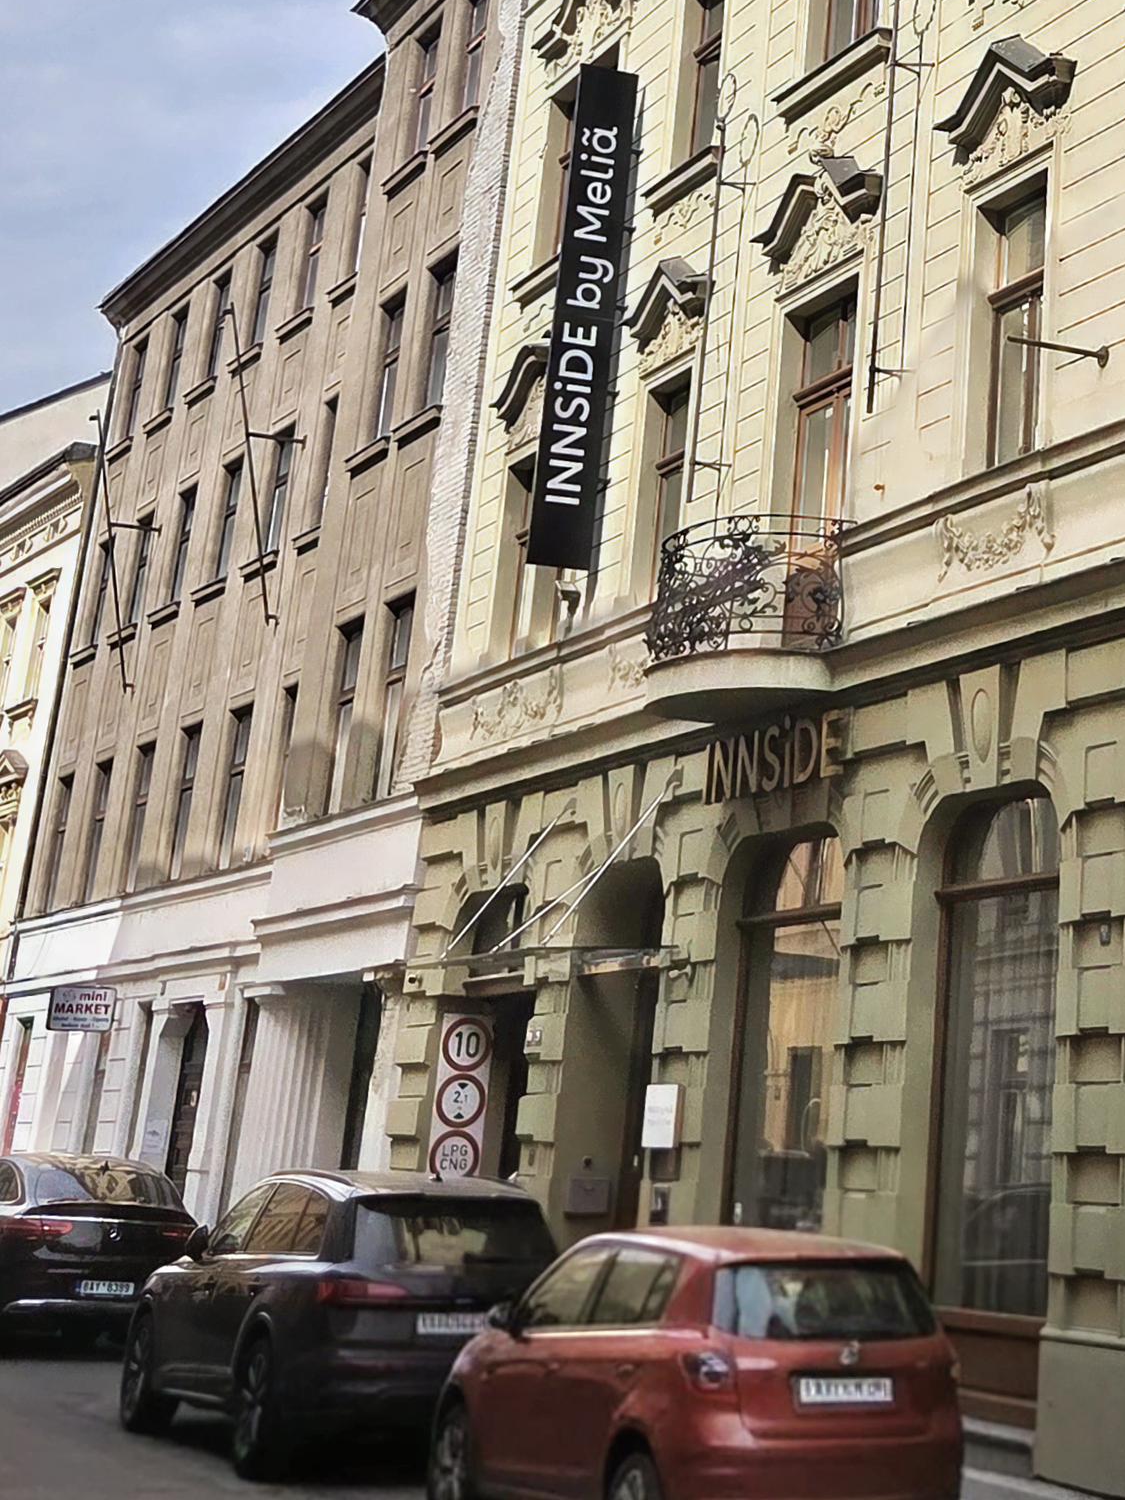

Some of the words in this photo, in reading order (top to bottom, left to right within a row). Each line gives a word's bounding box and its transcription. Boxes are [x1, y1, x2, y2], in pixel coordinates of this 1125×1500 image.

[566, 255, 614, 309] by
[79, 991, 107, 1001] mini
[54, 1003, 111, 1015] MARKET
[455, 1031, 481, 1058] 10
[442, 1144, 468, 1157] LPG
[440, 1158, 468, 1171] CNG
